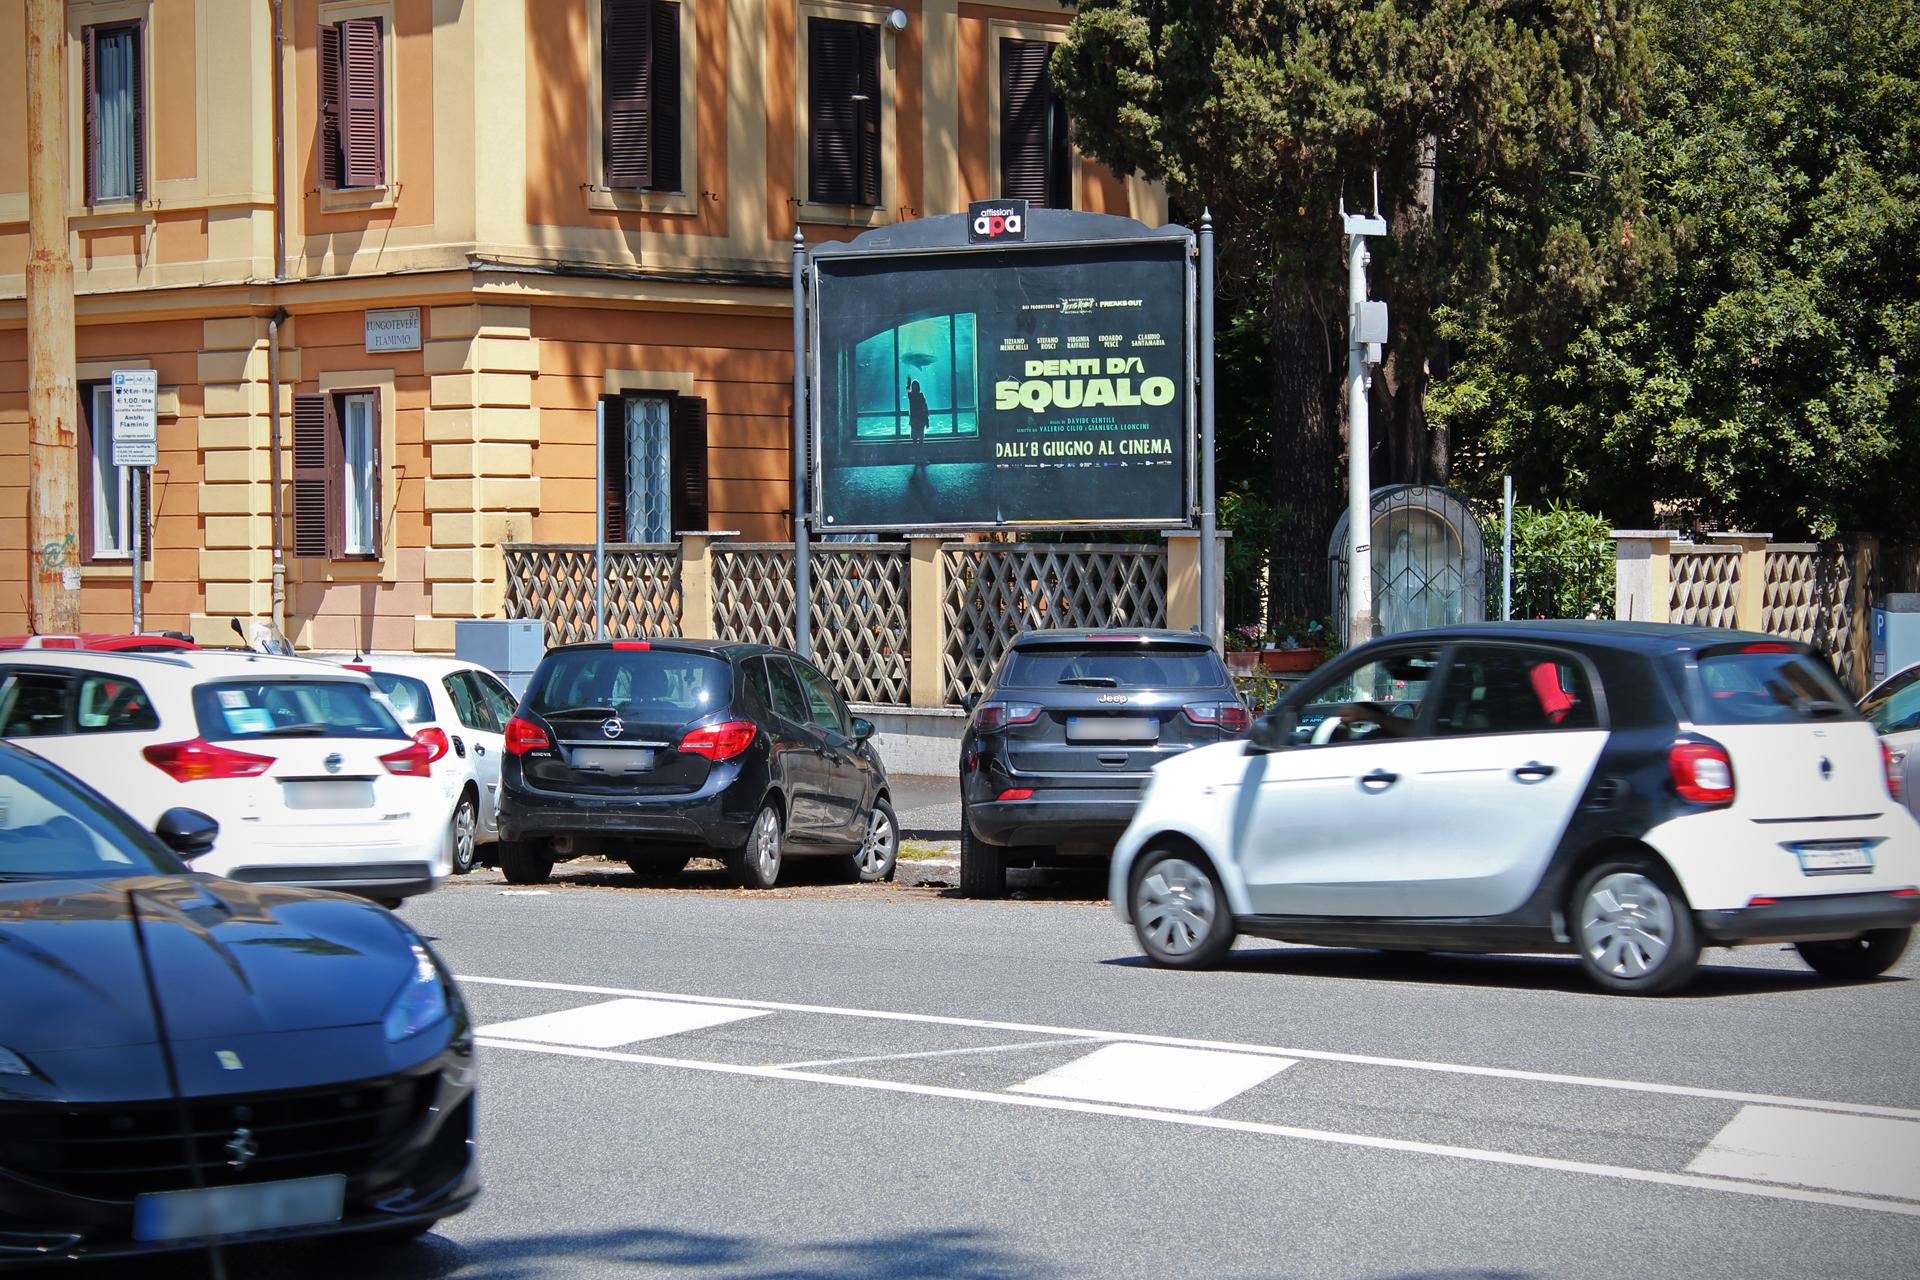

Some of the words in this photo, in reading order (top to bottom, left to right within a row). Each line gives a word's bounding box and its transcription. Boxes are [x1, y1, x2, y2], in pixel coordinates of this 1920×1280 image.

[981, 208, 1014, 217] affissioni
[974, 215, 1022, 237] apa
[367, 319, 418, 331] LUNGOTEVERE
[375, 335, 411, 346] FLAMINIO
[1025, 358, 1100, 376] DENTI
[1107, 357, 1144, 374] DA
[996, 376, 1175, 413] SQUALO
[1043, 441, 1093, 456] GIUGNO
[1099, 440, 1114, 455] AL
[1119, 439, 1172, 455] CINEMA
[1877, 615, 1884, 636] P
[1099, 694, 1128, 704] Jeep
